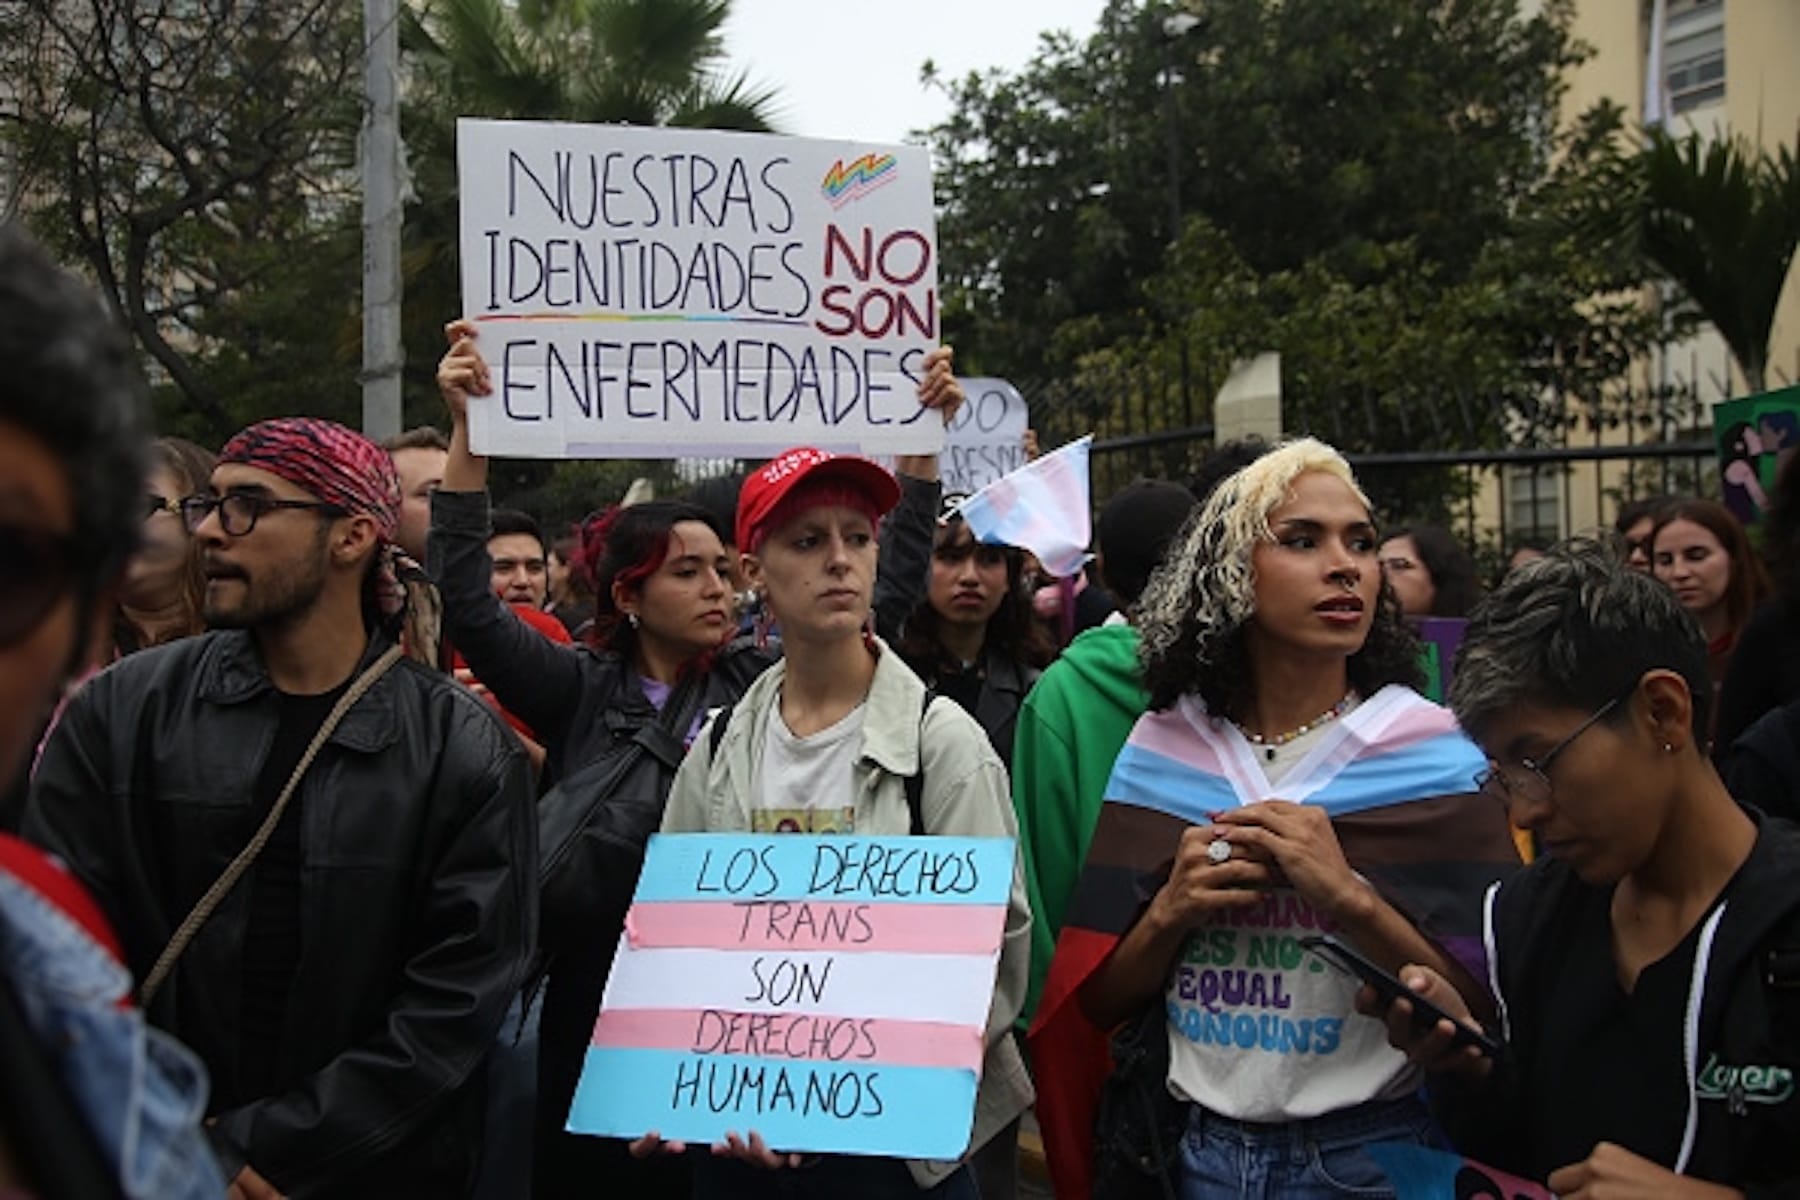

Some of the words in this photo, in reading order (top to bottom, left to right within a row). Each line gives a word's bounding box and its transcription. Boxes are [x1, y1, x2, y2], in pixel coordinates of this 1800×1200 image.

[509, 150, 793, 234] NUESTRAS
[486, 230, 811, 319] IDENTIDADES
[823, 223, 931, 286] NO
[814, 285, 935, 340] SON
[503, 339, 928, 426] ENFERMEDADES
[696, 845, 780, 897] LOS
[808, 843, 980, 897] DERECHOS
[734, 900, 875, 943] TRANS
[1184, 927, 1238, 967] ES
[1246, 933, 1327, 973] NO
[744, 957, 834, 1006] SON
[1177, 967, 1291, 1015] EQUAL
[691, 1009, 877, 1060] DERECHOS
[1167, 1002, 1343, 1054] RONOUNS
[672, 1060, 884, 1119] HUMANOS
